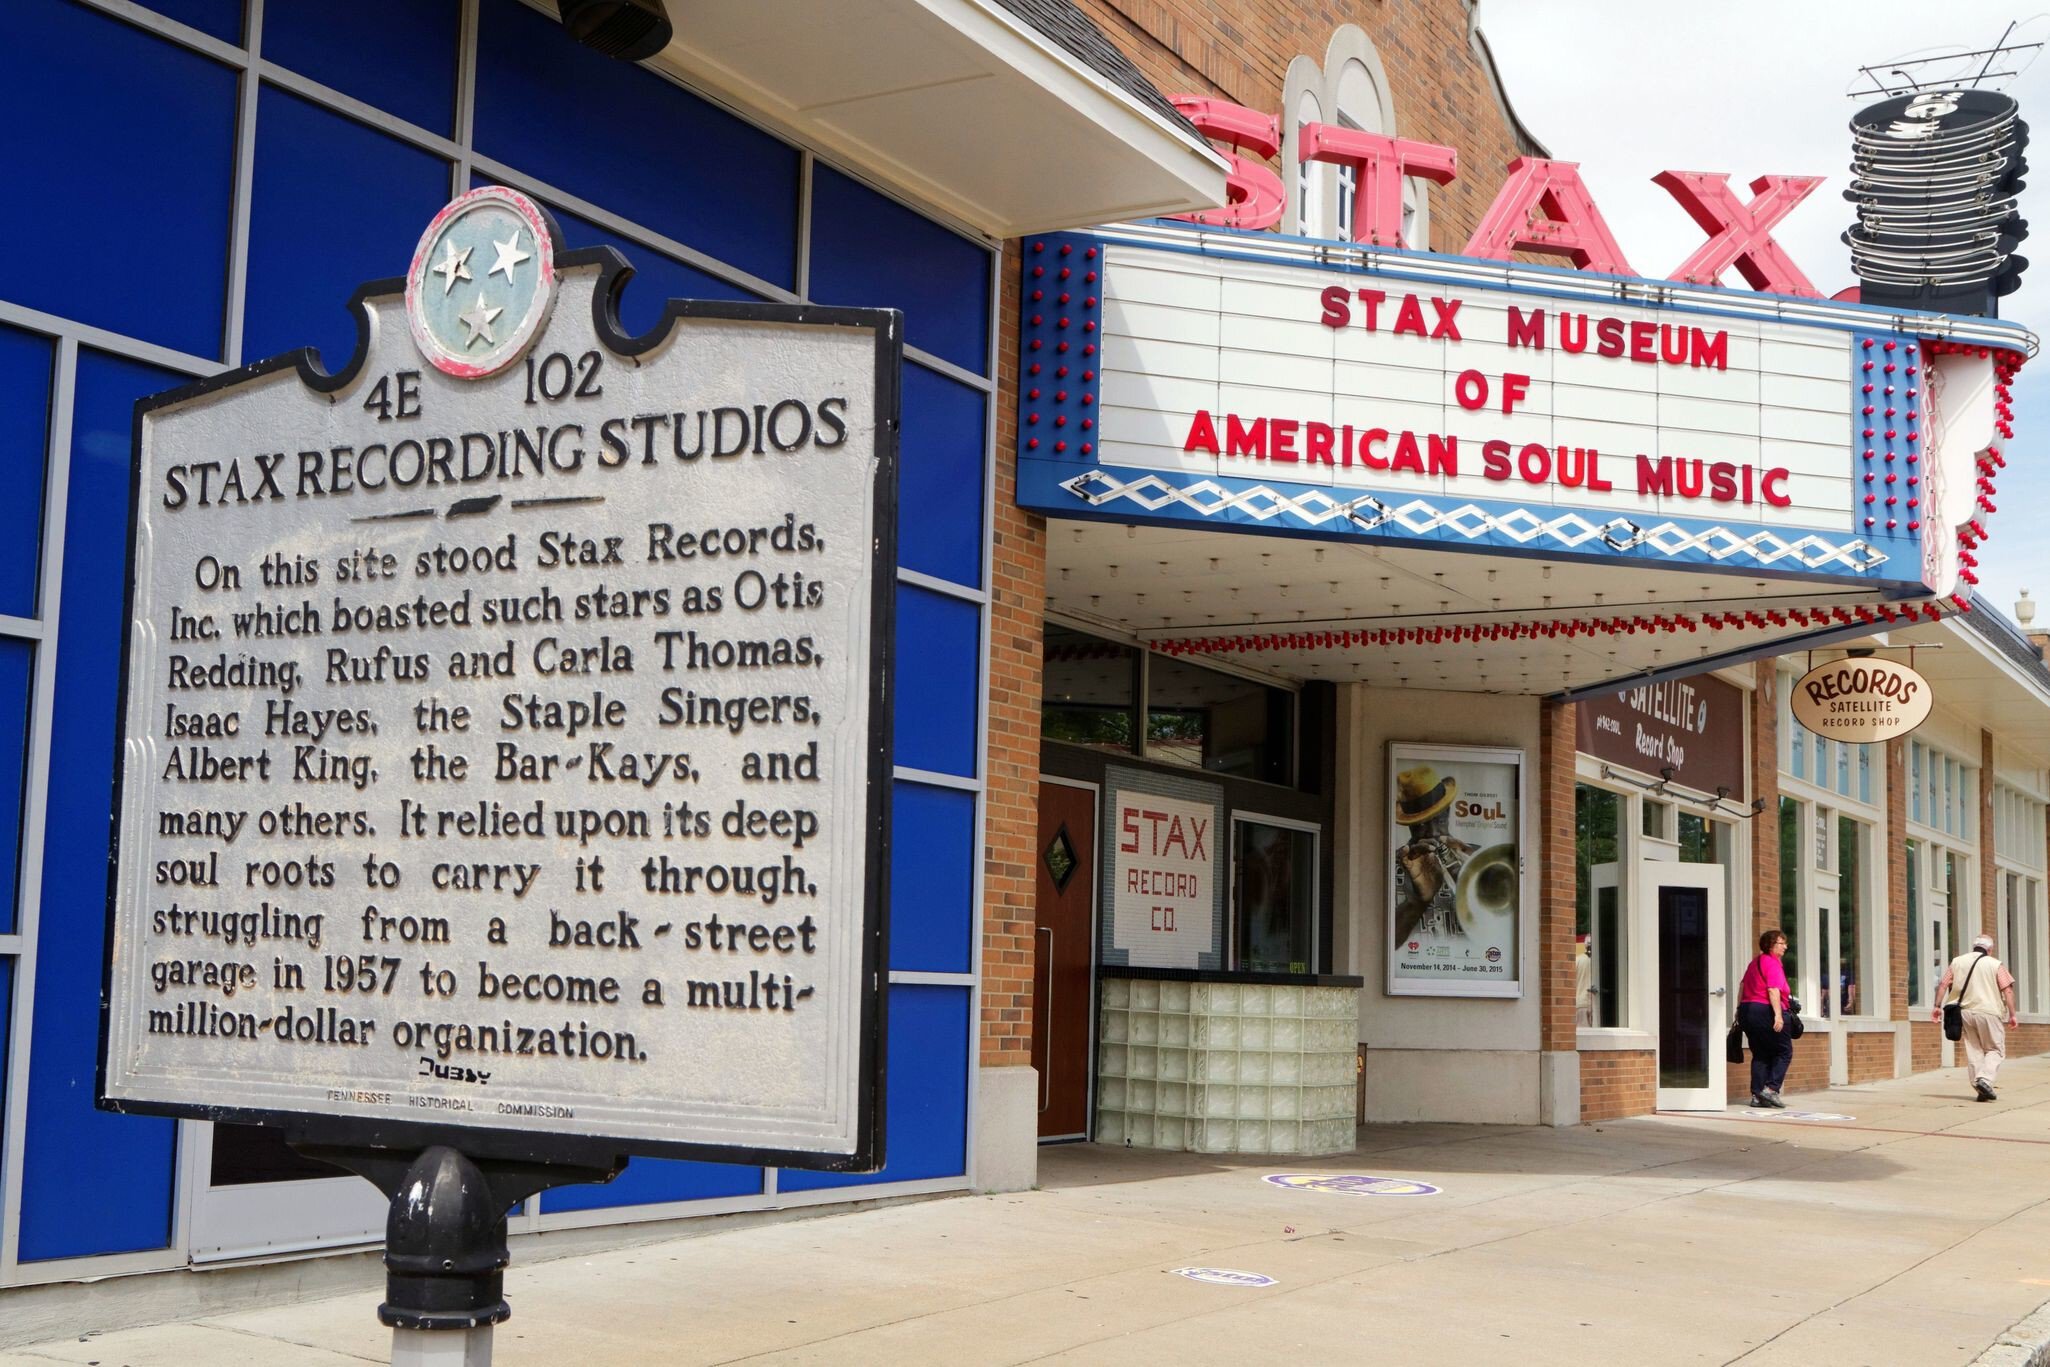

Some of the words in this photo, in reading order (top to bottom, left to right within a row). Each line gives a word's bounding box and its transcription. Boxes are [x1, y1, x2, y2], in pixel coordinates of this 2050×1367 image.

[1162, 93, 1827, 299] STAX
[1321, 286, 1462, 341] STAX
[1506, 305, 1728, 371] MUSEUM
[362, 370, 422, 422] 4E
[522, 348, 603, 406] 102
[1455, 369, 1530, 415] OF
[162, 452, 285, 511] STAX
[295, 423, 586, 499] RECORDING
[597, 397, 847, 469] STUDIOS
[1183, 409, 1458, 478] AMERICAN
[1482, 439, 1613, 493] SOUL
[1636, 454, 1792, 507] MUSIC
[195, 555, 242, 592] On
[259, 552, 318, 588] this
[336, 547, 397, 582] site
[415, 534, 517, 578] stood
[537, 531, 623, 569] Stax
[169, 606, 220, 642] Inc.
[233, 600, 321, 638] which
[331, 590, 471, 634] boasted
[482, 586, 561, 625] such
[574, 584, 670, 619] stars
[682, 586, 722, 615] as
[734, 570, 823, 611] Otis
[325, 645, 429, 684] Rufus
[448, 640, 516, 679] and
[533, 636, 634, 676] Carla
[1805, 668, 1918, 706] RECORDS
[1830, 701, 1892, 713] SATELLITE
[164, 703, 239, 739] Isaac
[414, 699, 469, 733] the
[500, 691, 626, 738] Staple
[1823, 718, 1865, 727] RECORD
[1872, 717, 1900, 727] SHOP
[161, 745, 271, 782] Albert
[410, 744, 467, 781] the
[494, 742, 699, 789] Bar-Kays,
[741, 741, 819, 782] and
[1636, 722, 1664, 759] Record
[1667, 735, 1684, 771] Shop
[158, 811, 248, 844] many
[258, 802, 375, 837] others.
[400, 799, 427, 838] It
[437, 800, 545, 837] relied
[554, 809, 649, 846] upon
[663, 801, 709, 838] its
[722, 799, 818, 849] deep
[1121, 807, 1208, 861] STAX
[155, 851, 219, 887] soul
[245, 854, 335, 888] roots
[362, 853, 400, 889] to
[431, 863, 540, 898] carry
[575, 857, 604, 892] it
[1127, 868, 1197, 898] RECORD
[152, 907, 324, 950] struggling
[361, 905, 450, 943] from
[487, 917, 508, 945] a
[1151, 906, 1177, 932] CO.
[151, 960, 255, 997] garage
[273, 957, 305, 991] in
[324, 954, 401, 995] 1957
[419, 963, 456, 997] to
[477, 961, 620, 1004] become
[641, 979, 664, 1006] a
[686, 970, 814, 1012] multi-
[1400, 962, 1432, 970] November
[148, 1003, 376, 1046] million-dollar
[392, 1019, 647, 1061] organization.
[327, 1089, 392, 1105] TENNESSEE
[409, 1095, 474, 1112] HISTORICAL
[498, 1103, 575, 1119] COMMISSION
